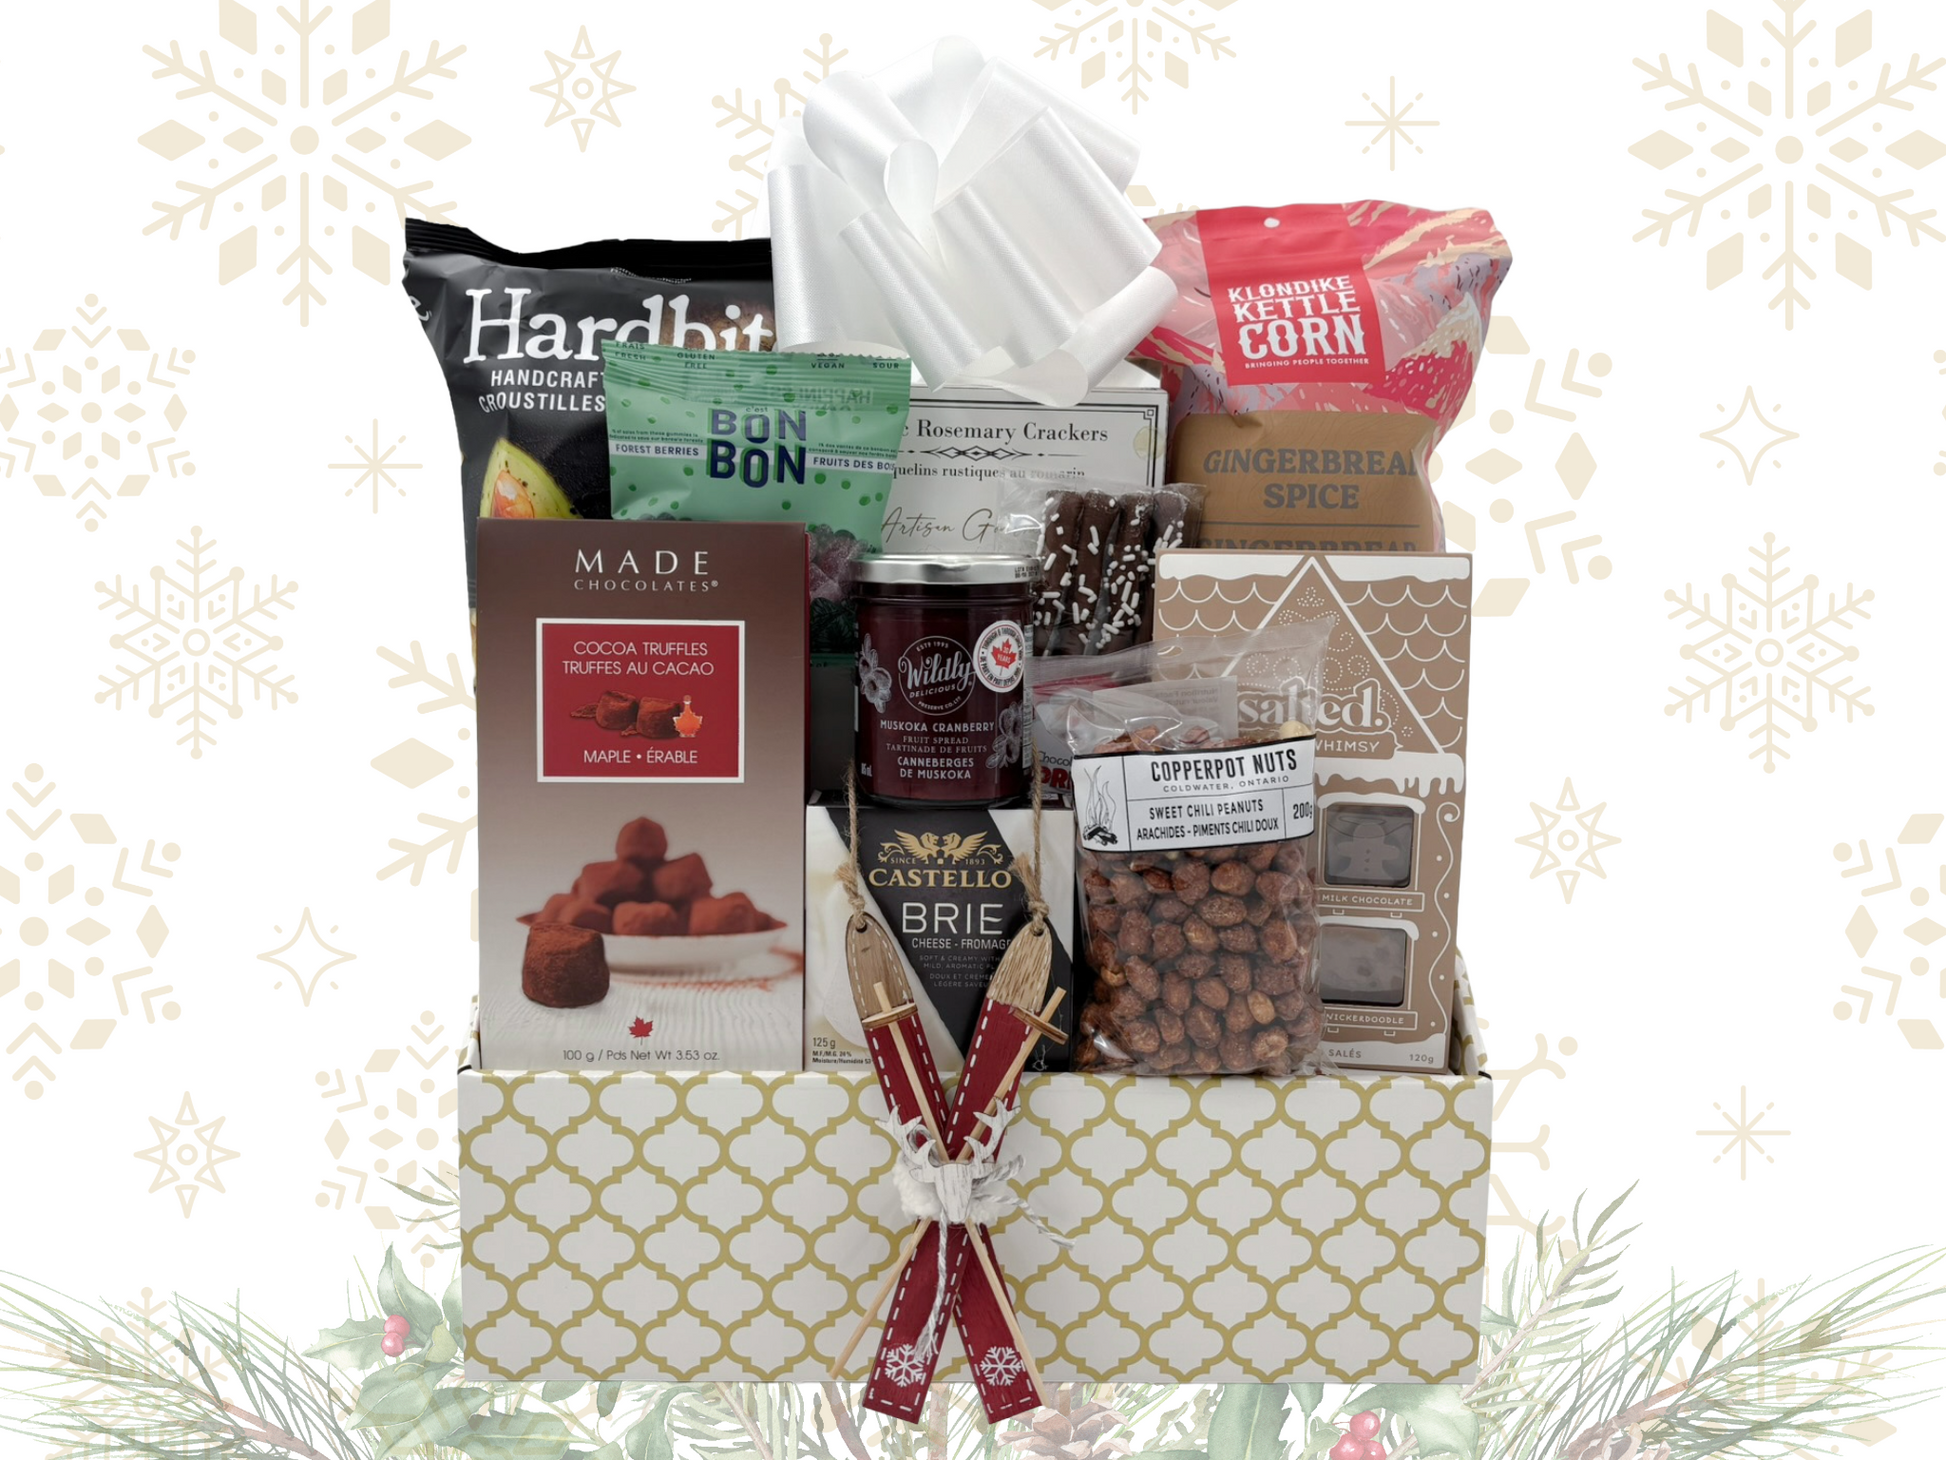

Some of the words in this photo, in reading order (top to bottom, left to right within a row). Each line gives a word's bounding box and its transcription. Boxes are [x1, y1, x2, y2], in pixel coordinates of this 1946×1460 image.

[1227, 275, 1353, 302] KLONDIKE
[1232, 290, 1361, 323] KETTLE
[1238, 314, 1366, 359] CORN
[677, 352, 715, 360] GLUTEN
[1245, 360, 1290, 369] BRINGING
[1326, 357, 1369, 365] TOGETHER
[491, 370, 604, 389] HANDCRAF
[478, 392, 606, 413] CROUSTILLES
[709, 408, 806, 444] BON
[917, 419, 1016, 445] Rosemary
[1023, 422, 1108, 442] Crackers
[616, 444, 651, 454] FOREST
[655, 445, 699, 456] BERRIES
[707, 439, 806, 488] BON
[813, 456, 850, 468] FRUITS
[853, 460, 874, 469] DES
[942, 466, 1004, 481] rustiques
[1010, 469, 1025, 479] au
[1263, 483, 1360, 510] SPICE
[575, 548, 709, 575] MADE
[573, 640, 637, 656] COCOA
[643, 641, 708, 657] TRUFFLES
[562, 660, 622, 675] TRUFFES
[626, 661, 648, 675] AU
[652, 661, 714, 676] CACAO
[898, 651, 976, 692] Wildly
[909, 683, 956, 699] DELICIOUS
[880, 720, 928, 732] MUSKOKA
[932, 721, 995, 732] CRANBERRY
[886, 743, 936, 753] TARTINADE
[940, 745, 952, 753] DE
[956, 745, 987, 753] FRUITS
[903, 735, 930, 744] FRUIT
[933, 736, 969, 745] SPREAD
[584, 750, 631, 764] MAPLE
[646, 747, 698, 764] ÉRABLE
[897, 757, 974, 767] CANNEBERGES
[900, 768, 913, 778] DE
[917, 769, 971, 779] MUSKOKA
[1151, 757, 1245, 782] COPPERPOT
[1252, 749, 1297, 775] NUTS
[1163, 782, 1234, 793] COLDWATER,
[1239, 775, 1289, 788] ONTARIO
[1149, 805, 1183, 820] SWEET
[1187, 802, 1214, 817] CHILI
[1218, 799, 1264, 815] PEANUTS
[1136, 825, 1185, 841] ARACHIDES
[1193, 822, 1231, 837] PIMENTS
[1232, 819, 1254, 834] CHILI
[1256, 817, 1279, 832] DOUX
[890, 857, 917, 865] SINCE
[868, 868, 1012, 889] CASTELLO
[1322, 894, 1348, 902] MILK
[1352, 895, 1413, 906] CHOCOLATE
[902, 902, 1003, 935] BRIE
[912, 938, 951, 949] CHEESE
[813, 1037, 828, 1048] 125
[830, 1039, 836, 1050] g
[563, 1050, 582, 1061] 100
[586, 1053, 595, 1063] g
[597, 1049, 604, 1061] /
[607, 1050, 627, 1061] Pds
[630, 1050, 651, 1061] Net
[655, 1050, 672, 1061] Wt
[675, 1050, 700, 1061] 3.53
[703, 1052, 721, 1061] oz.
[1328, 1048, 1362, 1059] SALÉS
[1409, 1053, 1434, 1064] 120g
